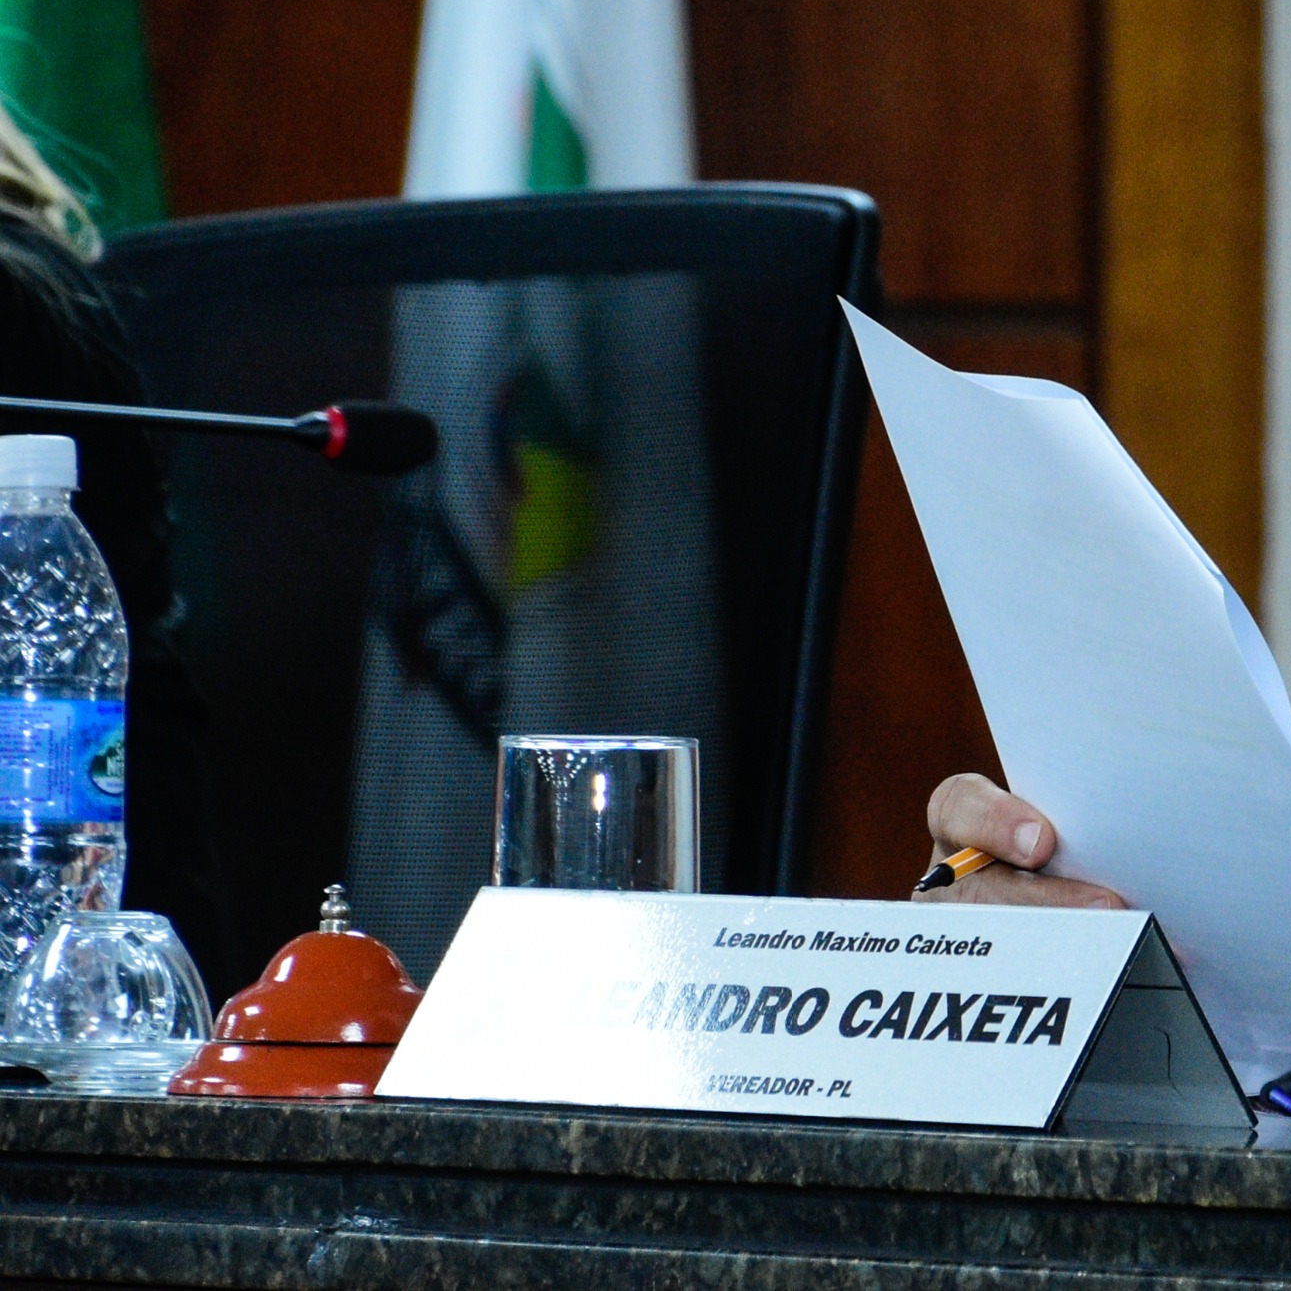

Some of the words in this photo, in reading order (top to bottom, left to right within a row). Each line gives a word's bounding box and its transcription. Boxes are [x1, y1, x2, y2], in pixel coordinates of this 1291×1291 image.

[713, 927, 806, 950] Leandro
[809, 930, 900, 953] Maximo
[905, 933, 993, 957] Caixeta
[838, 989, 1072, 1046] CAIXETA
[707, 1073, 815, 1097] VEREADOR
[826, 1079, 853, 1098] PL
